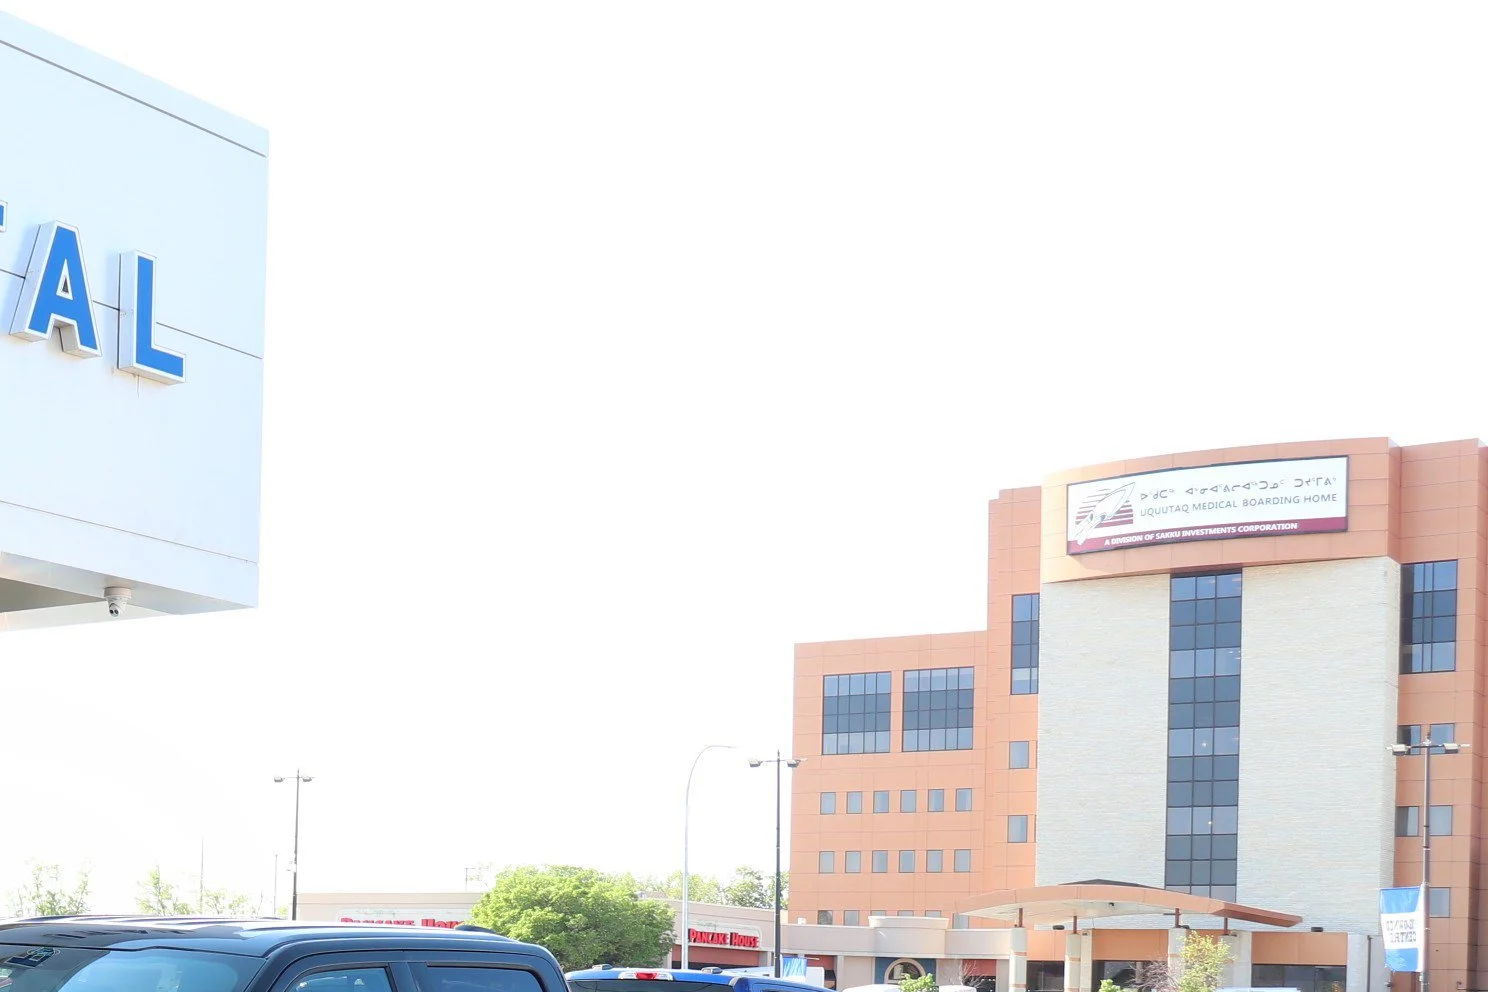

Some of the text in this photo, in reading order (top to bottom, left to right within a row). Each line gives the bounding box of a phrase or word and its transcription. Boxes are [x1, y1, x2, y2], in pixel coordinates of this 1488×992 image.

[1140, 493, 1338, 517] UQUUTAQ MEDICAL BOARDING HOME
[1111, 535, 1143, 545] DIVISION
[1144, 533, 1155, 542] OF
[1156, 529, 1181, 540] SAKKU
[1182, 526, 1237, 537] INVESTMENTS
[1237, 522, 1298, 533] CORPORATION
[688, 928, 760, 948] PANCAKE HOUSE
